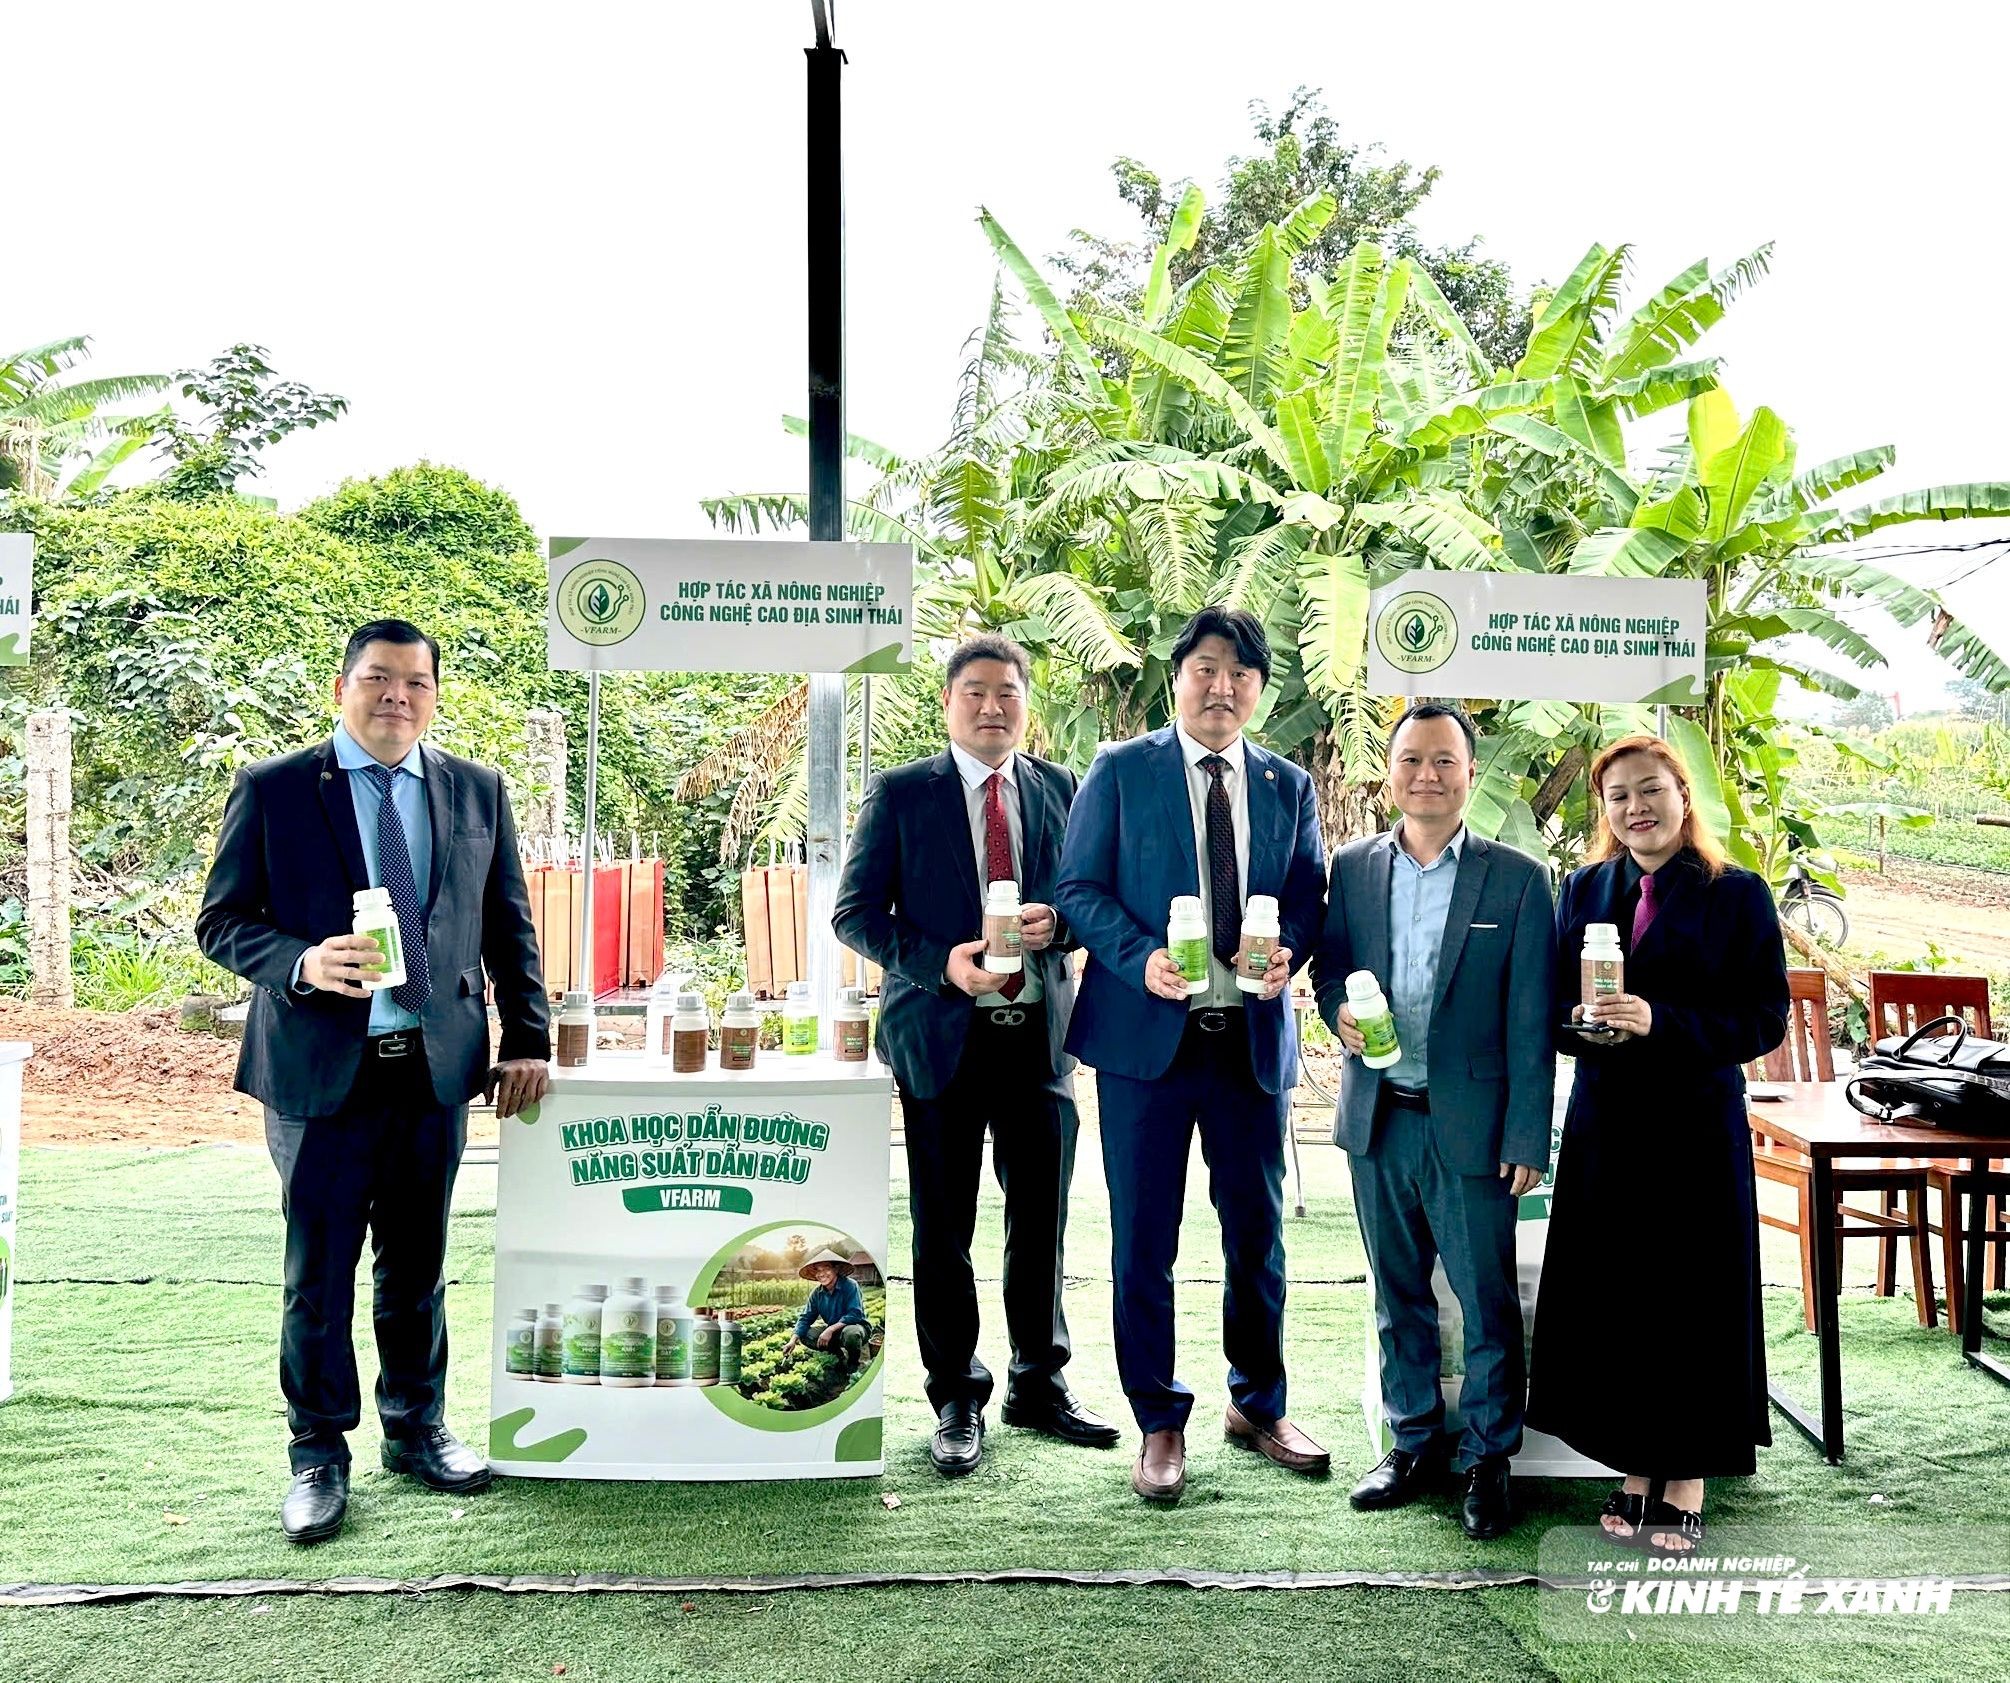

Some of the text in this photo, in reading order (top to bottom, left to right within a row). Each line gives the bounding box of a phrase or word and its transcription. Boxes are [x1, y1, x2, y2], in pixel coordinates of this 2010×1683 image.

[678, 579, 885, 605] HỢP TÁC XÃ NÔNG NGHIỆP
[660, 601, 903, 626] CÔNG NGHỆ CAO ĐỊA SINH THÁI
[1489, 612, 1680, 639] HỢP TÁC XÃ NÔNG NGHIỆP
[1471, 631, 1696, 658] CÔNG NGHỆ CAO ĐỊA SINH THÁI
[561, 1106, 827, 1149] KHOA HỌC DẪN ĐƯỜNG
[571, 1142, 808, 1183] NĂNG SUẤT DẪN ĐẦU
[660, 1188, 721, 1208] VFARM
